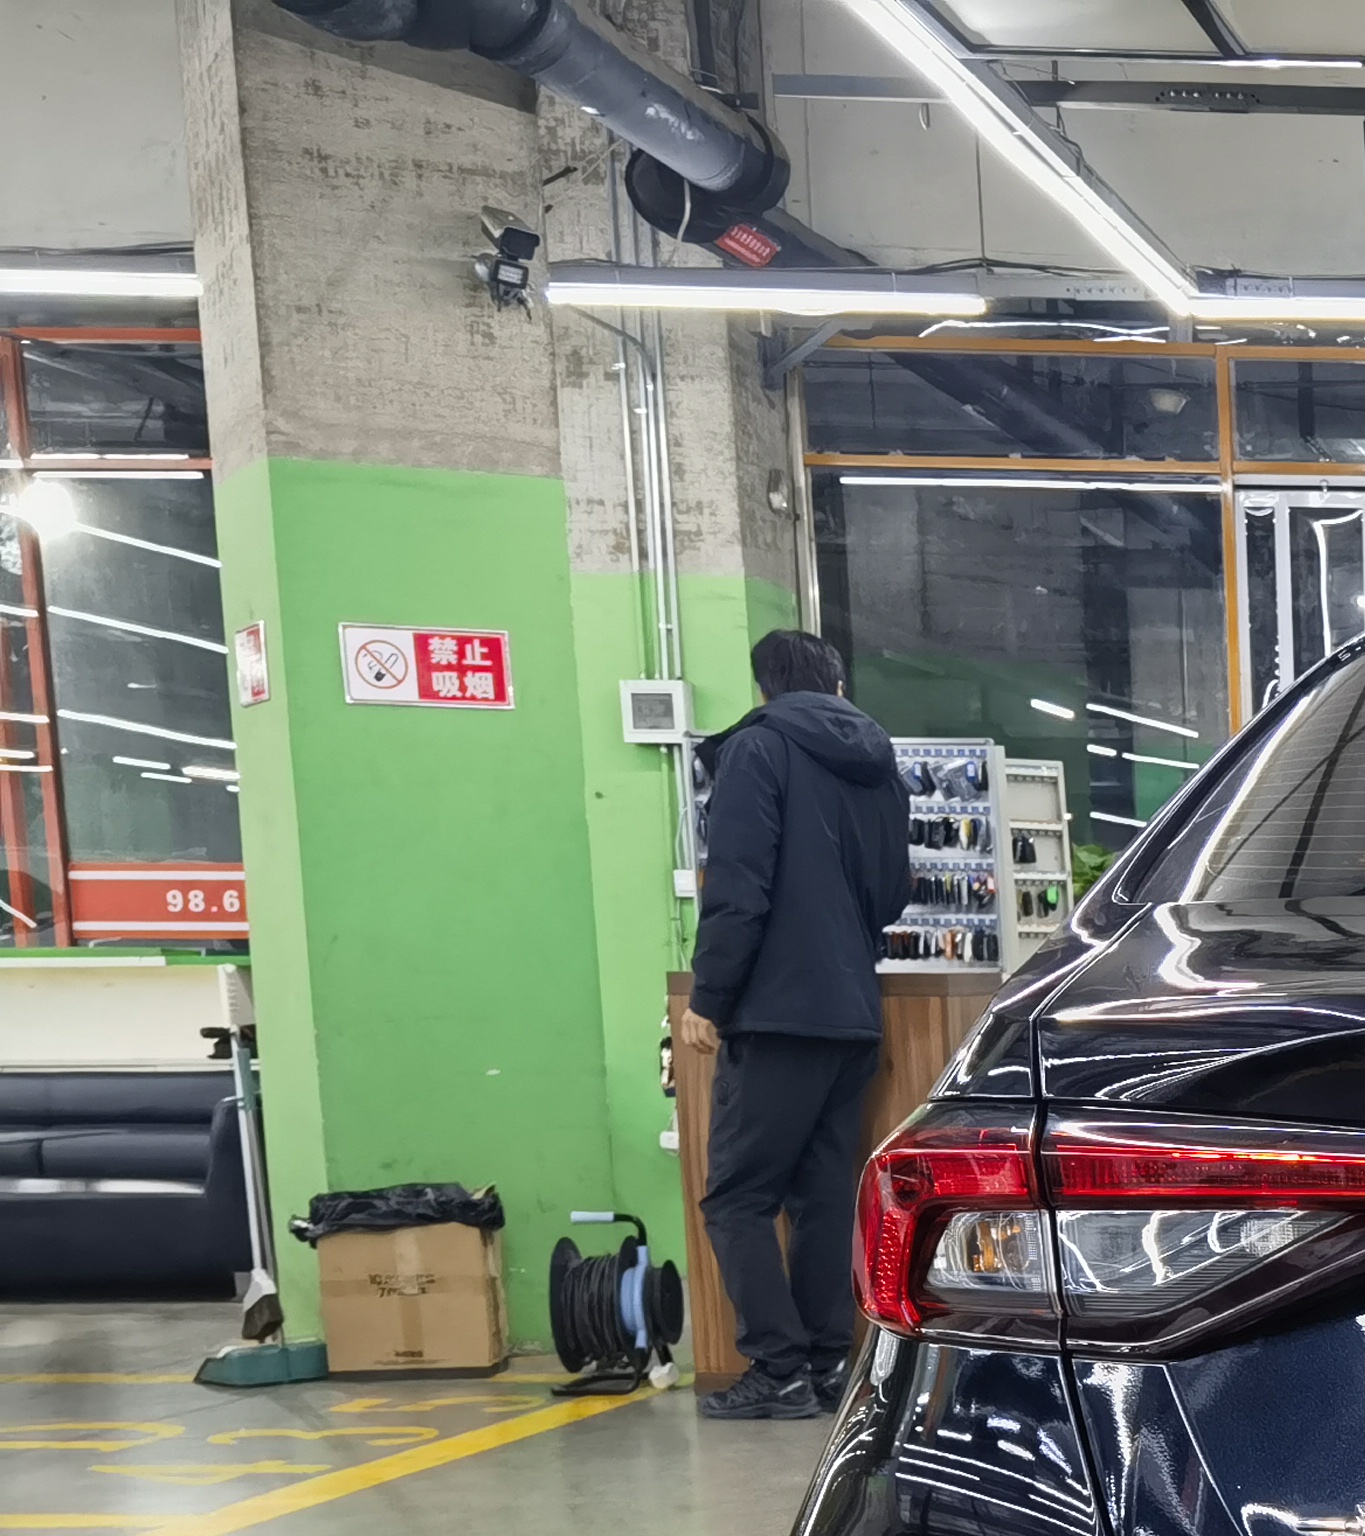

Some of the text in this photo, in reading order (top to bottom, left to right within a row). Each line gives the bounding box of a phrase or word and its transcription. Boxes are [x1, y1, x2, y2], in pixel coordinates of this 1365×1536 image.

[428, 636, 492, 667] 禁止
[431, 671, 496, 700] 吸烟
[165, 889, 241, 913] 98.6
